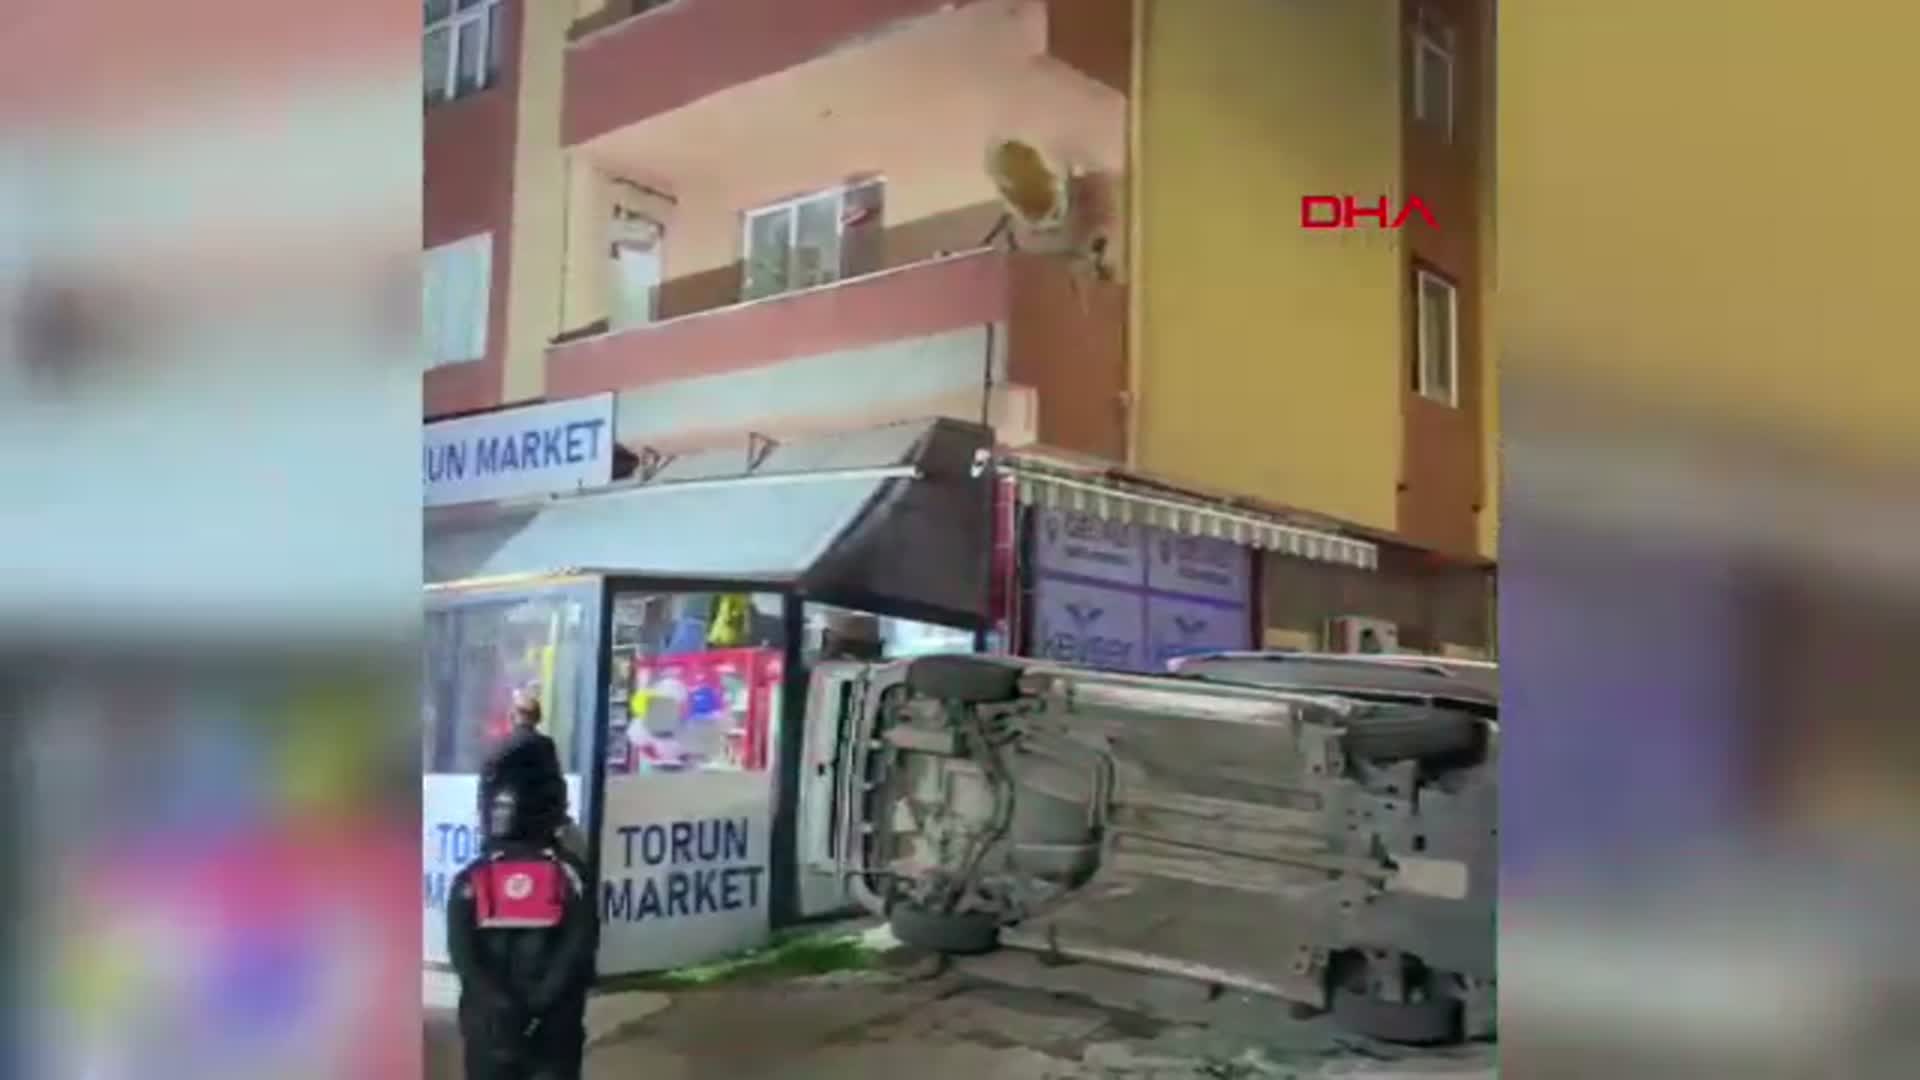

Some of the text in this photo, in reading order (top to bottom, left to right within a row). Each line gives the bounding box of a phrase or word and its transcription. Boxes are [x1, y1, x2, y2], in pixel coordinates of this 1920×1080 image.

[424, 418, 605, 484] UN MARKET
[616, 818, 750, 867] TORUN
[602, 866, 765, 927] MARKET
